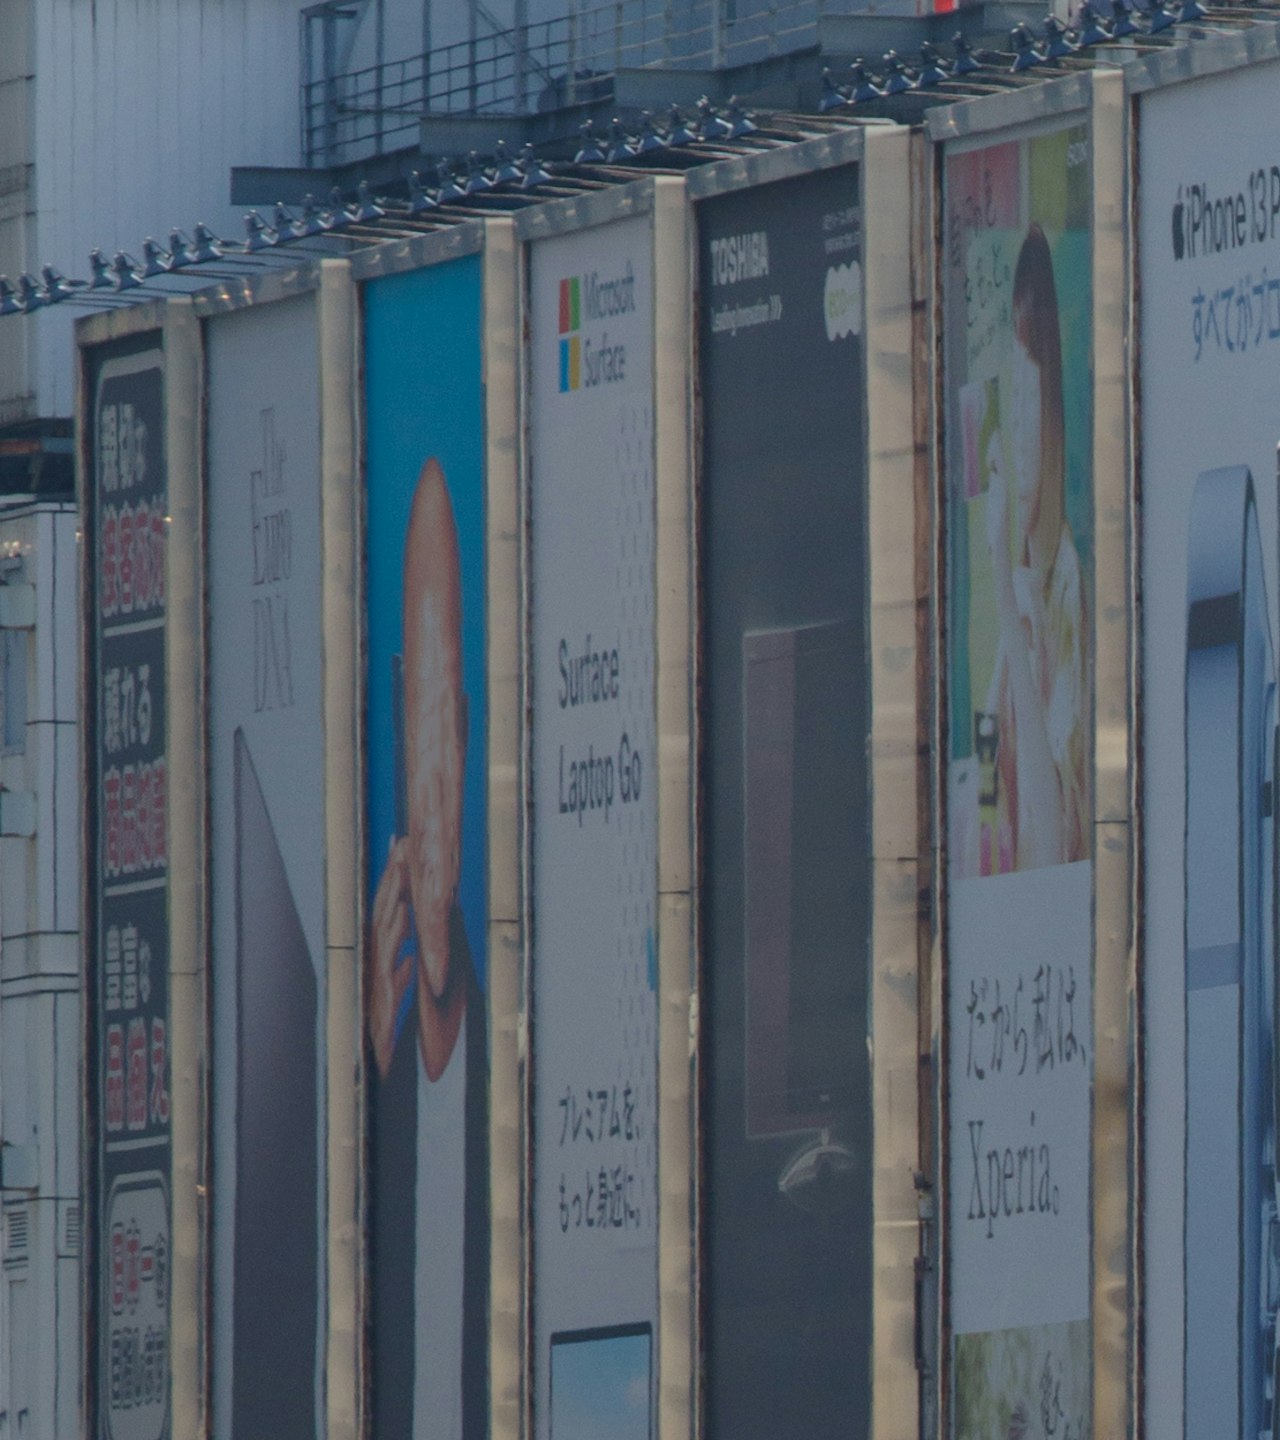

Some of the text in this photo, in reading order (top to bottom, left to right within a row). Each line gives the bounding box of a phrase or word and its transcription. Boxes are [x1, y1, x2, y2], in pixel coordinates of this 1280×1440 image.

[1185, 178, 1246, 260] iPhone
[1248, 171, 1268, 245] 13
[584, 260, 636, 322] Microsoft
[710, 231, 769, 286] TOSHIBA
[584, 332, 626, 388] Surface
[558, 632, 620, 710] Surface
[559, 732, 642, 829] Laptop Go
[967, 964, 1087, 1080] だから私は、
